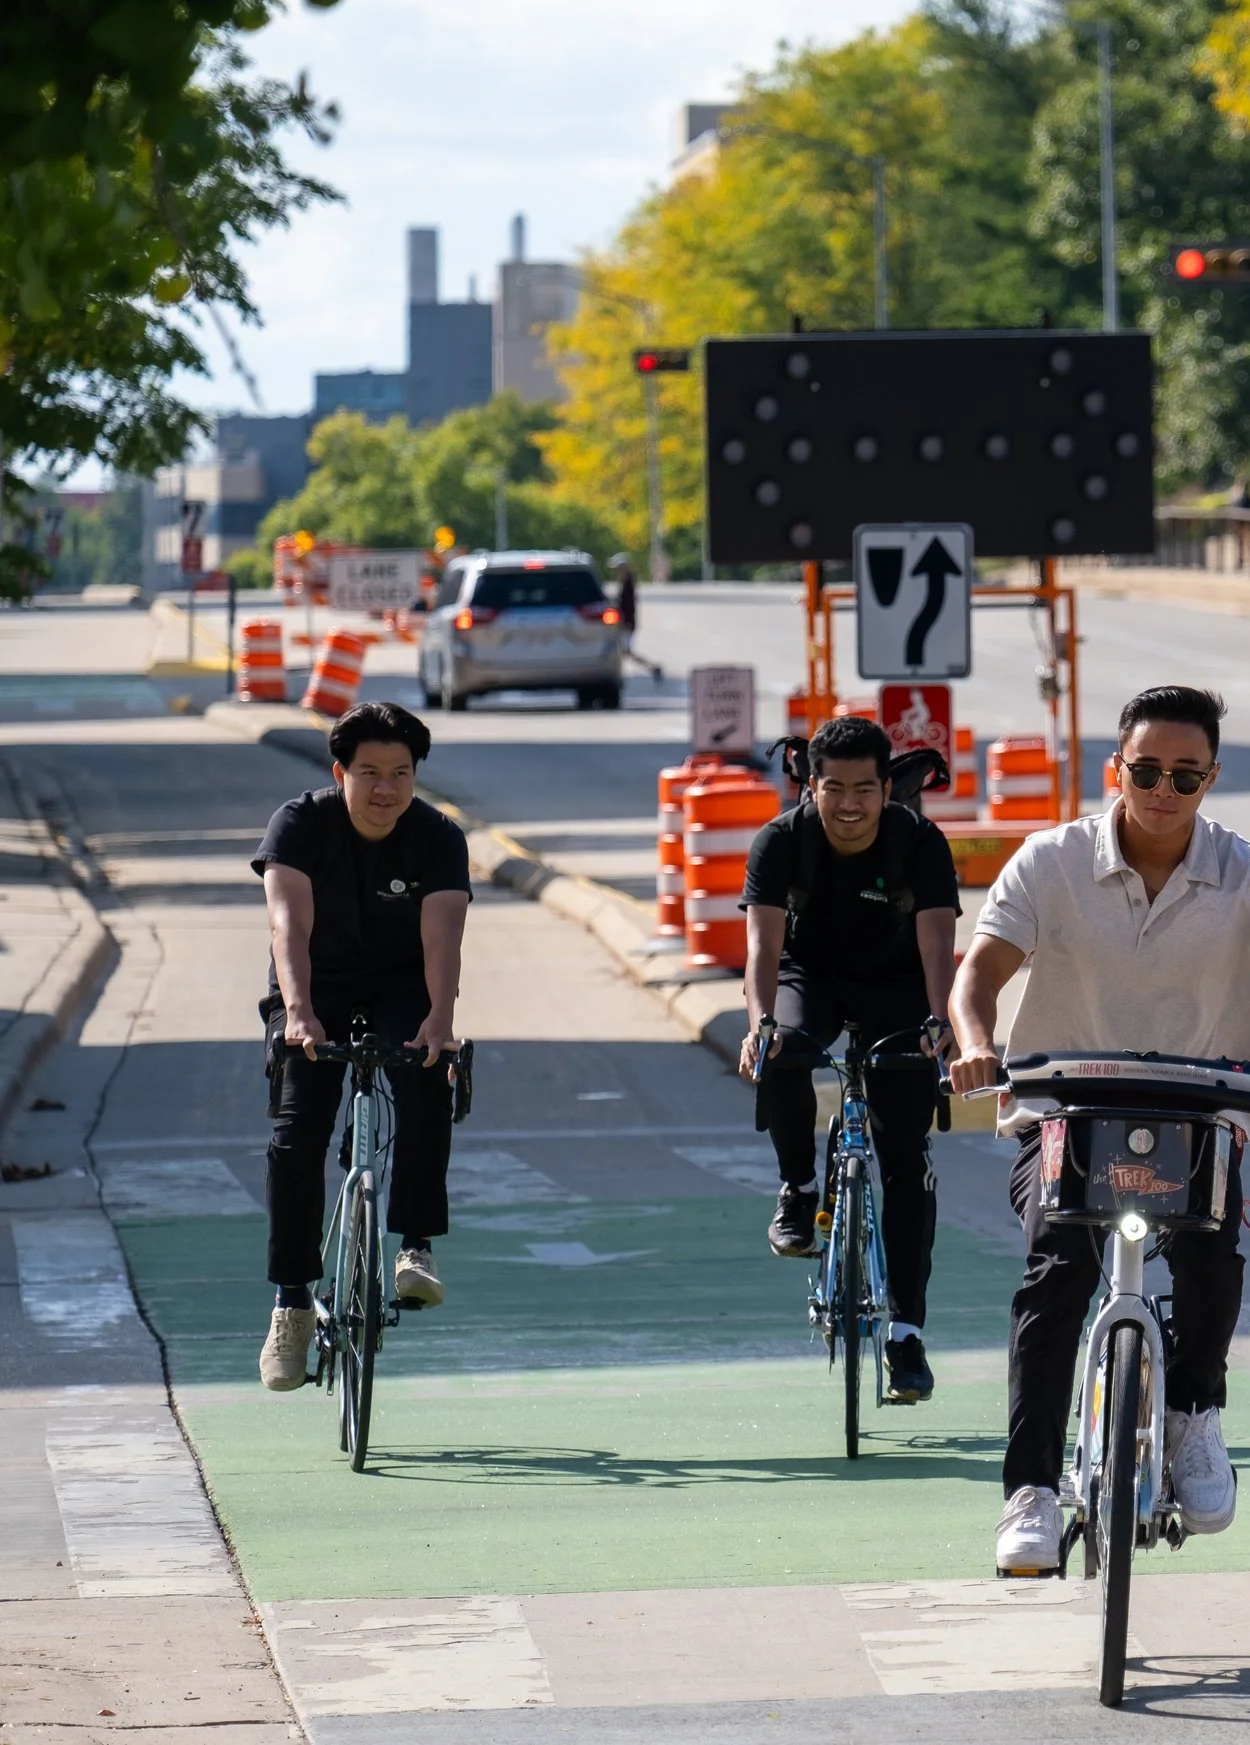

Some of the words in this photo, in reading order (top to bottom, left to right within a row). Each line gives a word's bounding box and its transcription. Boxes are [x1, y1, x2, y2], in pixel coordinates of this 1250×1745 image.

[346, 562, 400, 581] LANE
[336, 583, 415, 605] CLOSED
[1114, 1168, 1151, 1188] TREK
[1150, 1181, 1169, 1191] 100
